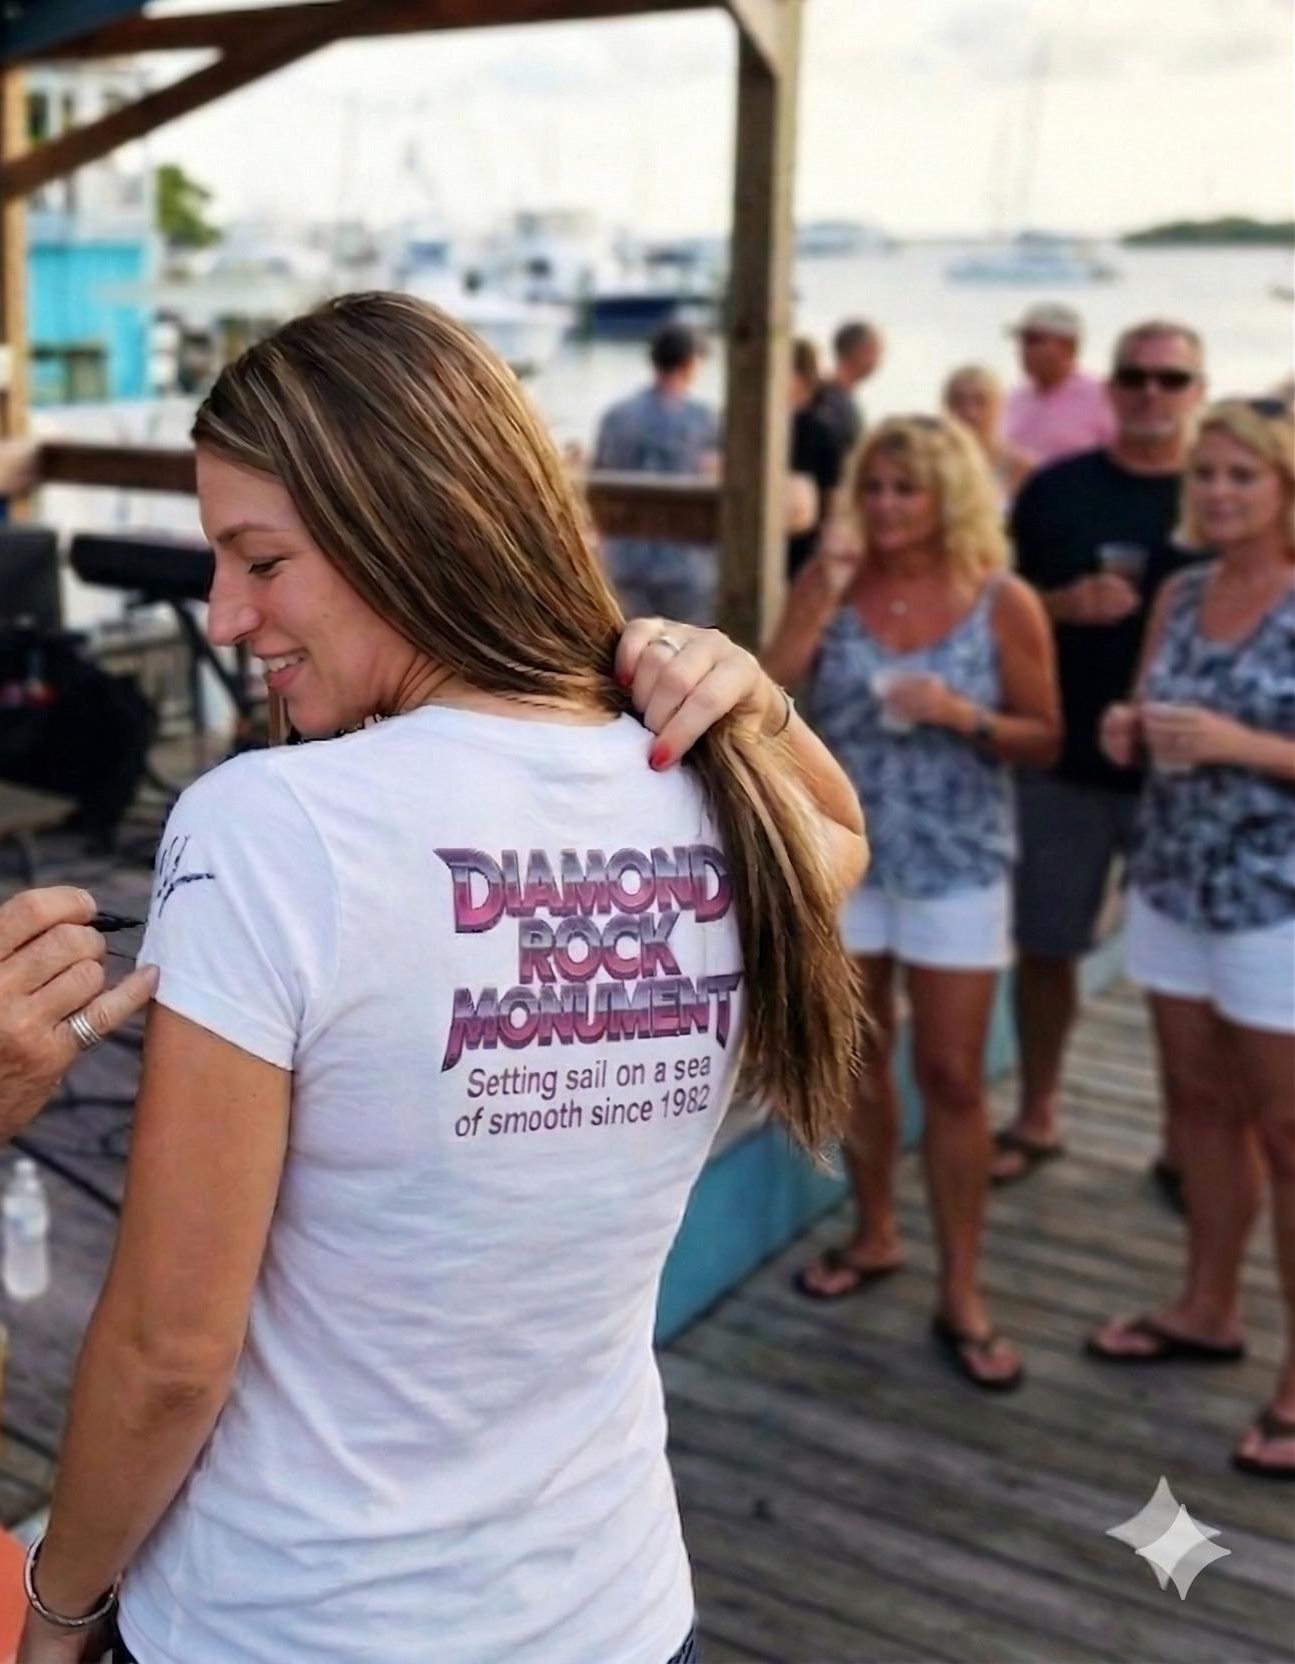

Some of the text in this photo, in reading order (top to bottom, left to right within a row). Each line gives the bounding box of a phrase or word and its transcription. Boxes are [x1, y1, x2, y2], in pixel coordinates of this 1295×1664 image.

[433, 845, 734, 933] DIAMOND
[518, 911, 682, 985] ROCK
[441, 973, 742, 1073] MONUMENT
[455, 1084, 710, 1137] of smooth since 1982
[467, 1055, 711, 1100] Setting sail on a sea
